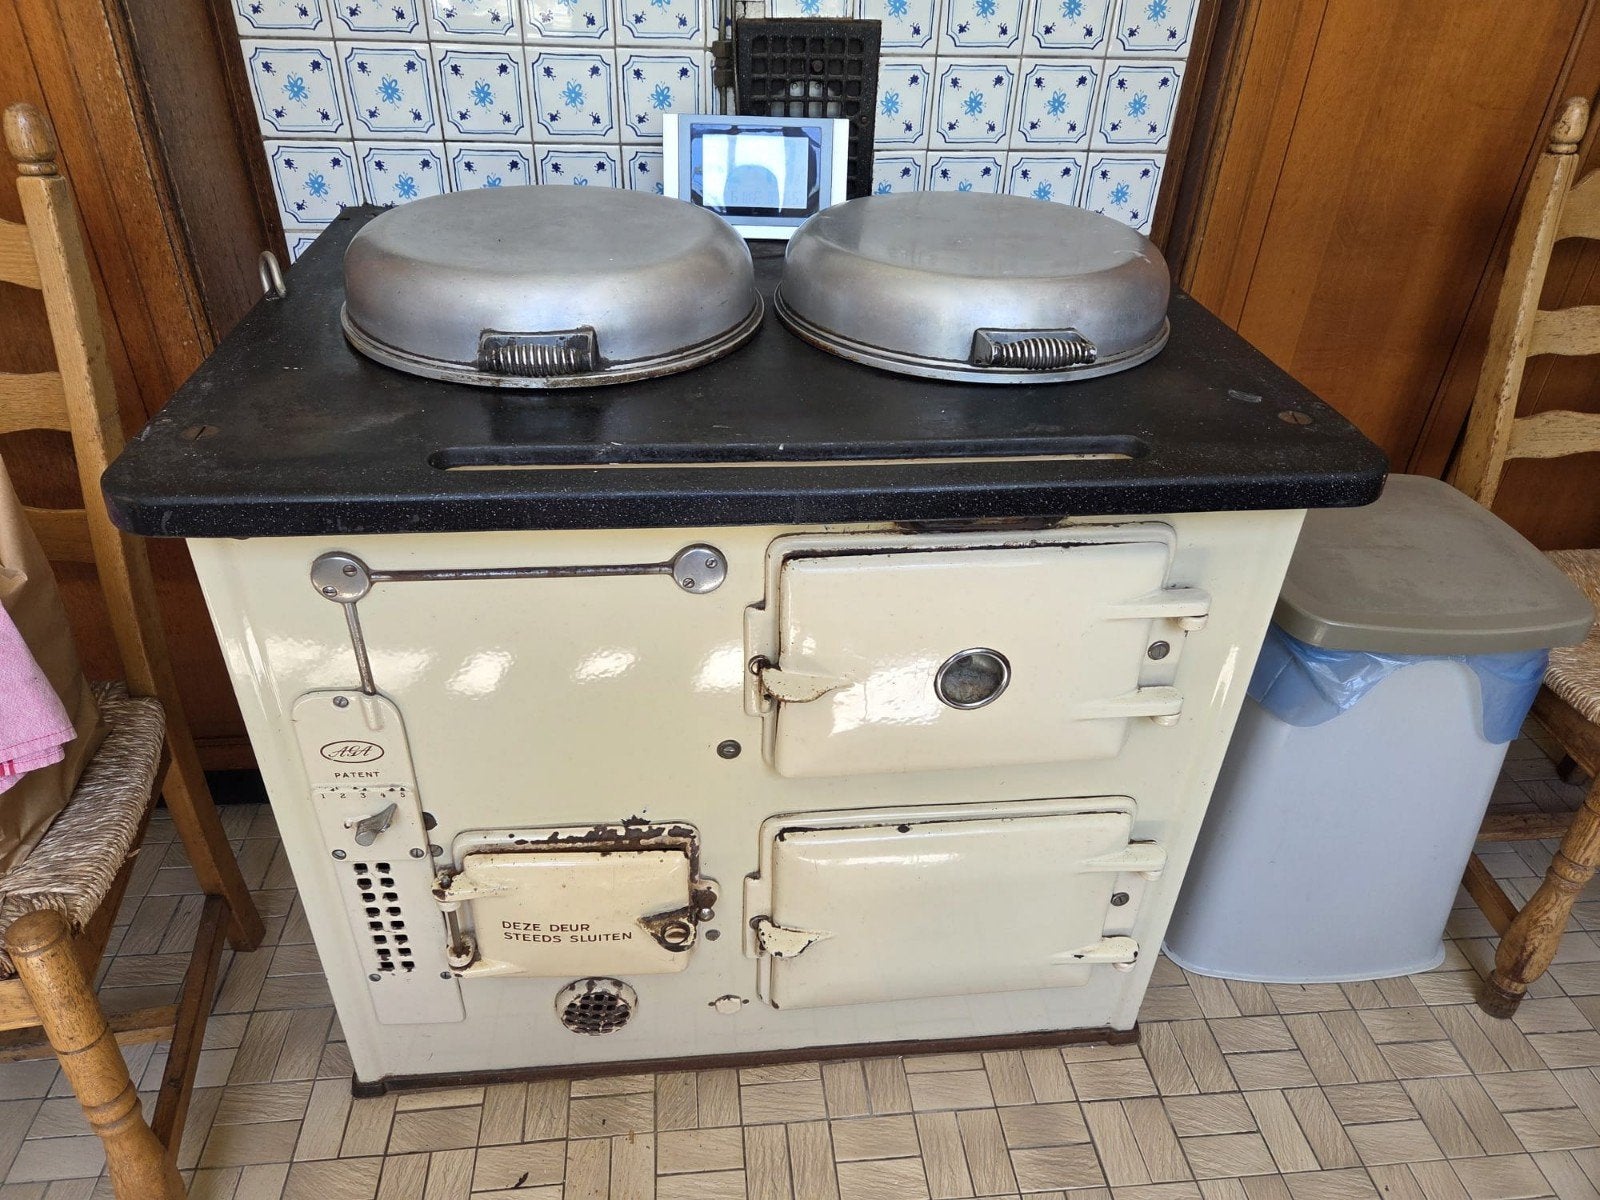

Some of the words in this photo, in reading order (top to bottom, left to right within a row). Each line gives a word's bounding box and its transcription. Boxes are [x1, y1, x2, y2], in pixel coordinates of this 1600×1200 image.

[328, 745, 373, 758] AGA
[334, 771, 380, 779] PATENT
[502, 920, 541, 931] DEZE
[549, 923, 590, 932] DEUR
[504, 931, 562, 943] STEEDS
[570, 931, 632, 943] SLUITEN
